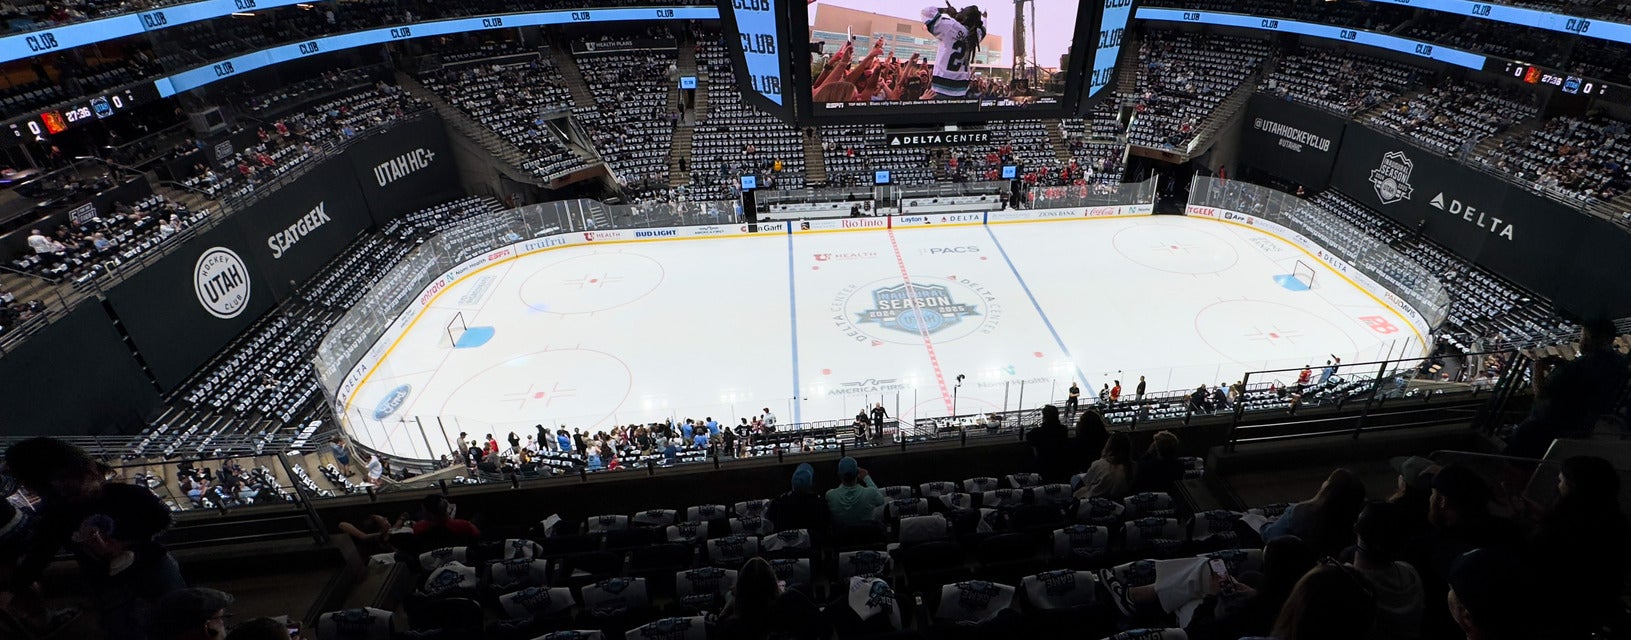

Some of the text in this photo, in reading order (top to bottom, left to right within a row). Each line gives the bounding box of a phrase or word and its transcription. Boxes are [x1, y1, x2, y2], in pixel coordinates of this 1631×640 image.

[236, 0, 256, 10] CLUB
[1472, 4, 1492, 16] CLUB
[144, 11, 168, 28] CLUB
[571, 11, 591, 21] CLUB
[656, 9, 674, 18] CLUB
[1183, 12, 1200, 21] CLUB
[482, 17, 503, 28] CLUB
[1261, 18, 1278, 29] CLUB
[1565, 18, 1591, 33] CLUB
[391, 27, 411, 39] CLUB
[1340, 29, 1357, 40] CLUB
[25, 32, 59, 52] CLUB
[299, 41, 319, 55] CLUB
[740, 33, 775, 54] CLUB
[1415, 43, 1433, 56] CLUB
[214, 61, 234, 77] CLUB
[751, 75, 781, 95] LUB
[1514, 67, 1523, 77] 0
[1583, 83, 1593, 94] 0
[28, 121, 41, 135] 0
[66, 107, 91, 122] 27:36
[112, 96, 123, 108] 0
[903, 133, 988, 145] DELTA CENTER
[1254, 117, 1330, 152] @UTAHHOCKEYCLUB
[373, 148, 435, 187] UTAH HC+
[1381, 164, 1408, 184] SEASON
[950, 214, 980, 222] DELTA
[1449, 199, 1514, 241] DELTA
[267, 200, 331, 259] SEATGEEK
[653, 229, 677, 237] LIGHT
[488, 250, 511, 261] ESPN
[930, 245, 980, 255] PACS
[202, 255, 230, 277] HOCKEY
[1323, 253, 1347, 272] DELTA
[204, 264, 243, 303] UTAH
[960, 278, 996, 302] DELTA
[421, 279, 446, 306] entrata
[224, 294, 243, 310] CLUB
[878, 296, 951, 310] SEASON
[939, 305, 965, 313] 2025
[870, 310, 896, 318] 2024
[833, 315, 868, 342] DELTA
[344, 364, 367, 393] DELTA
[828, 386, 877, 396] AMERICA
[378, 389, 407, 414] Ford
